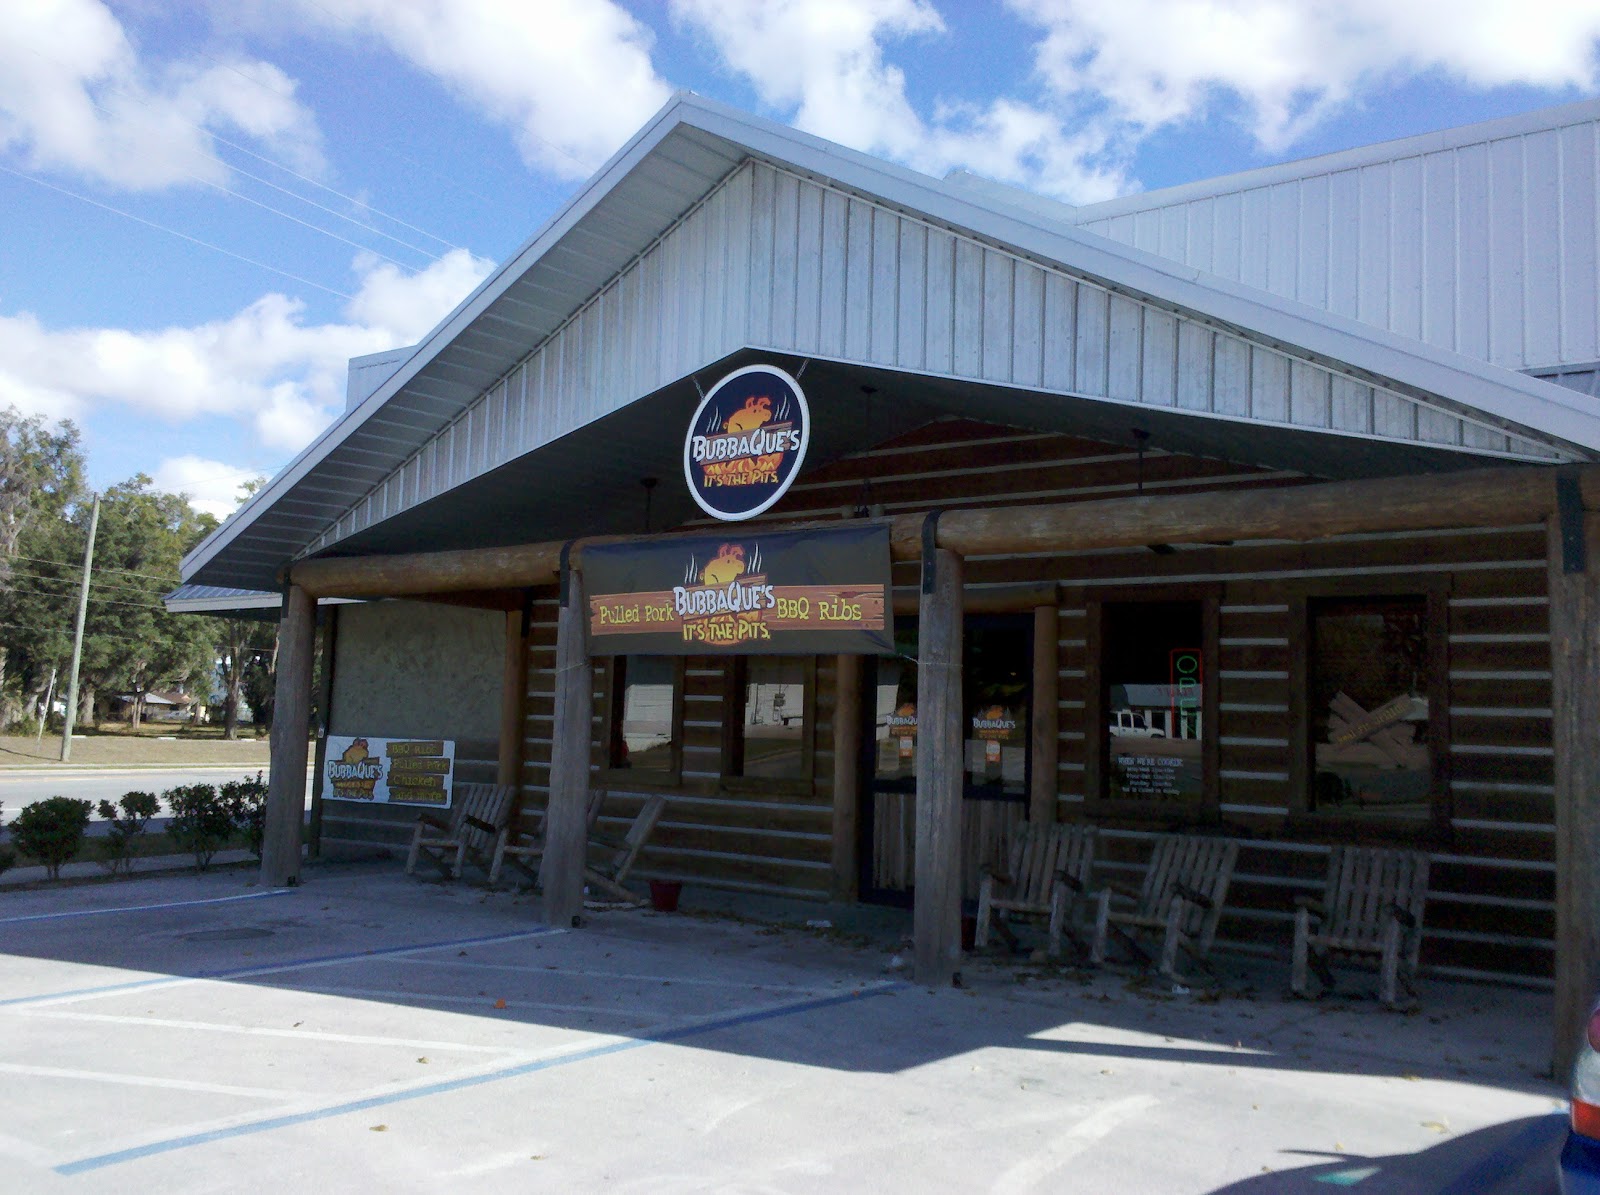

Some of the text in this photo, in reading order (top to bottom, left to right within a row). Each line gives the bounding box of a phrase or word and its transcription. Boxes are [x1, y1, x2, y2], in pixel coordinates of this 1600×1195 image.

[692, 428, 800, 462] BUBBAQUE'S
[704, 473, 723, 488] IT'S
[727, 472, 749, 486] THE
[673, 580, 776, 616] BUBBAQUE'S
[776, 597, 862, 621] BBQ Ribs
[599, 602, 674, 624] Pulled Pork
[683, 622, 706, 641] IT'S
[708, 621, 734, 640] THE
[393, 775, 437, 787] Chicken
